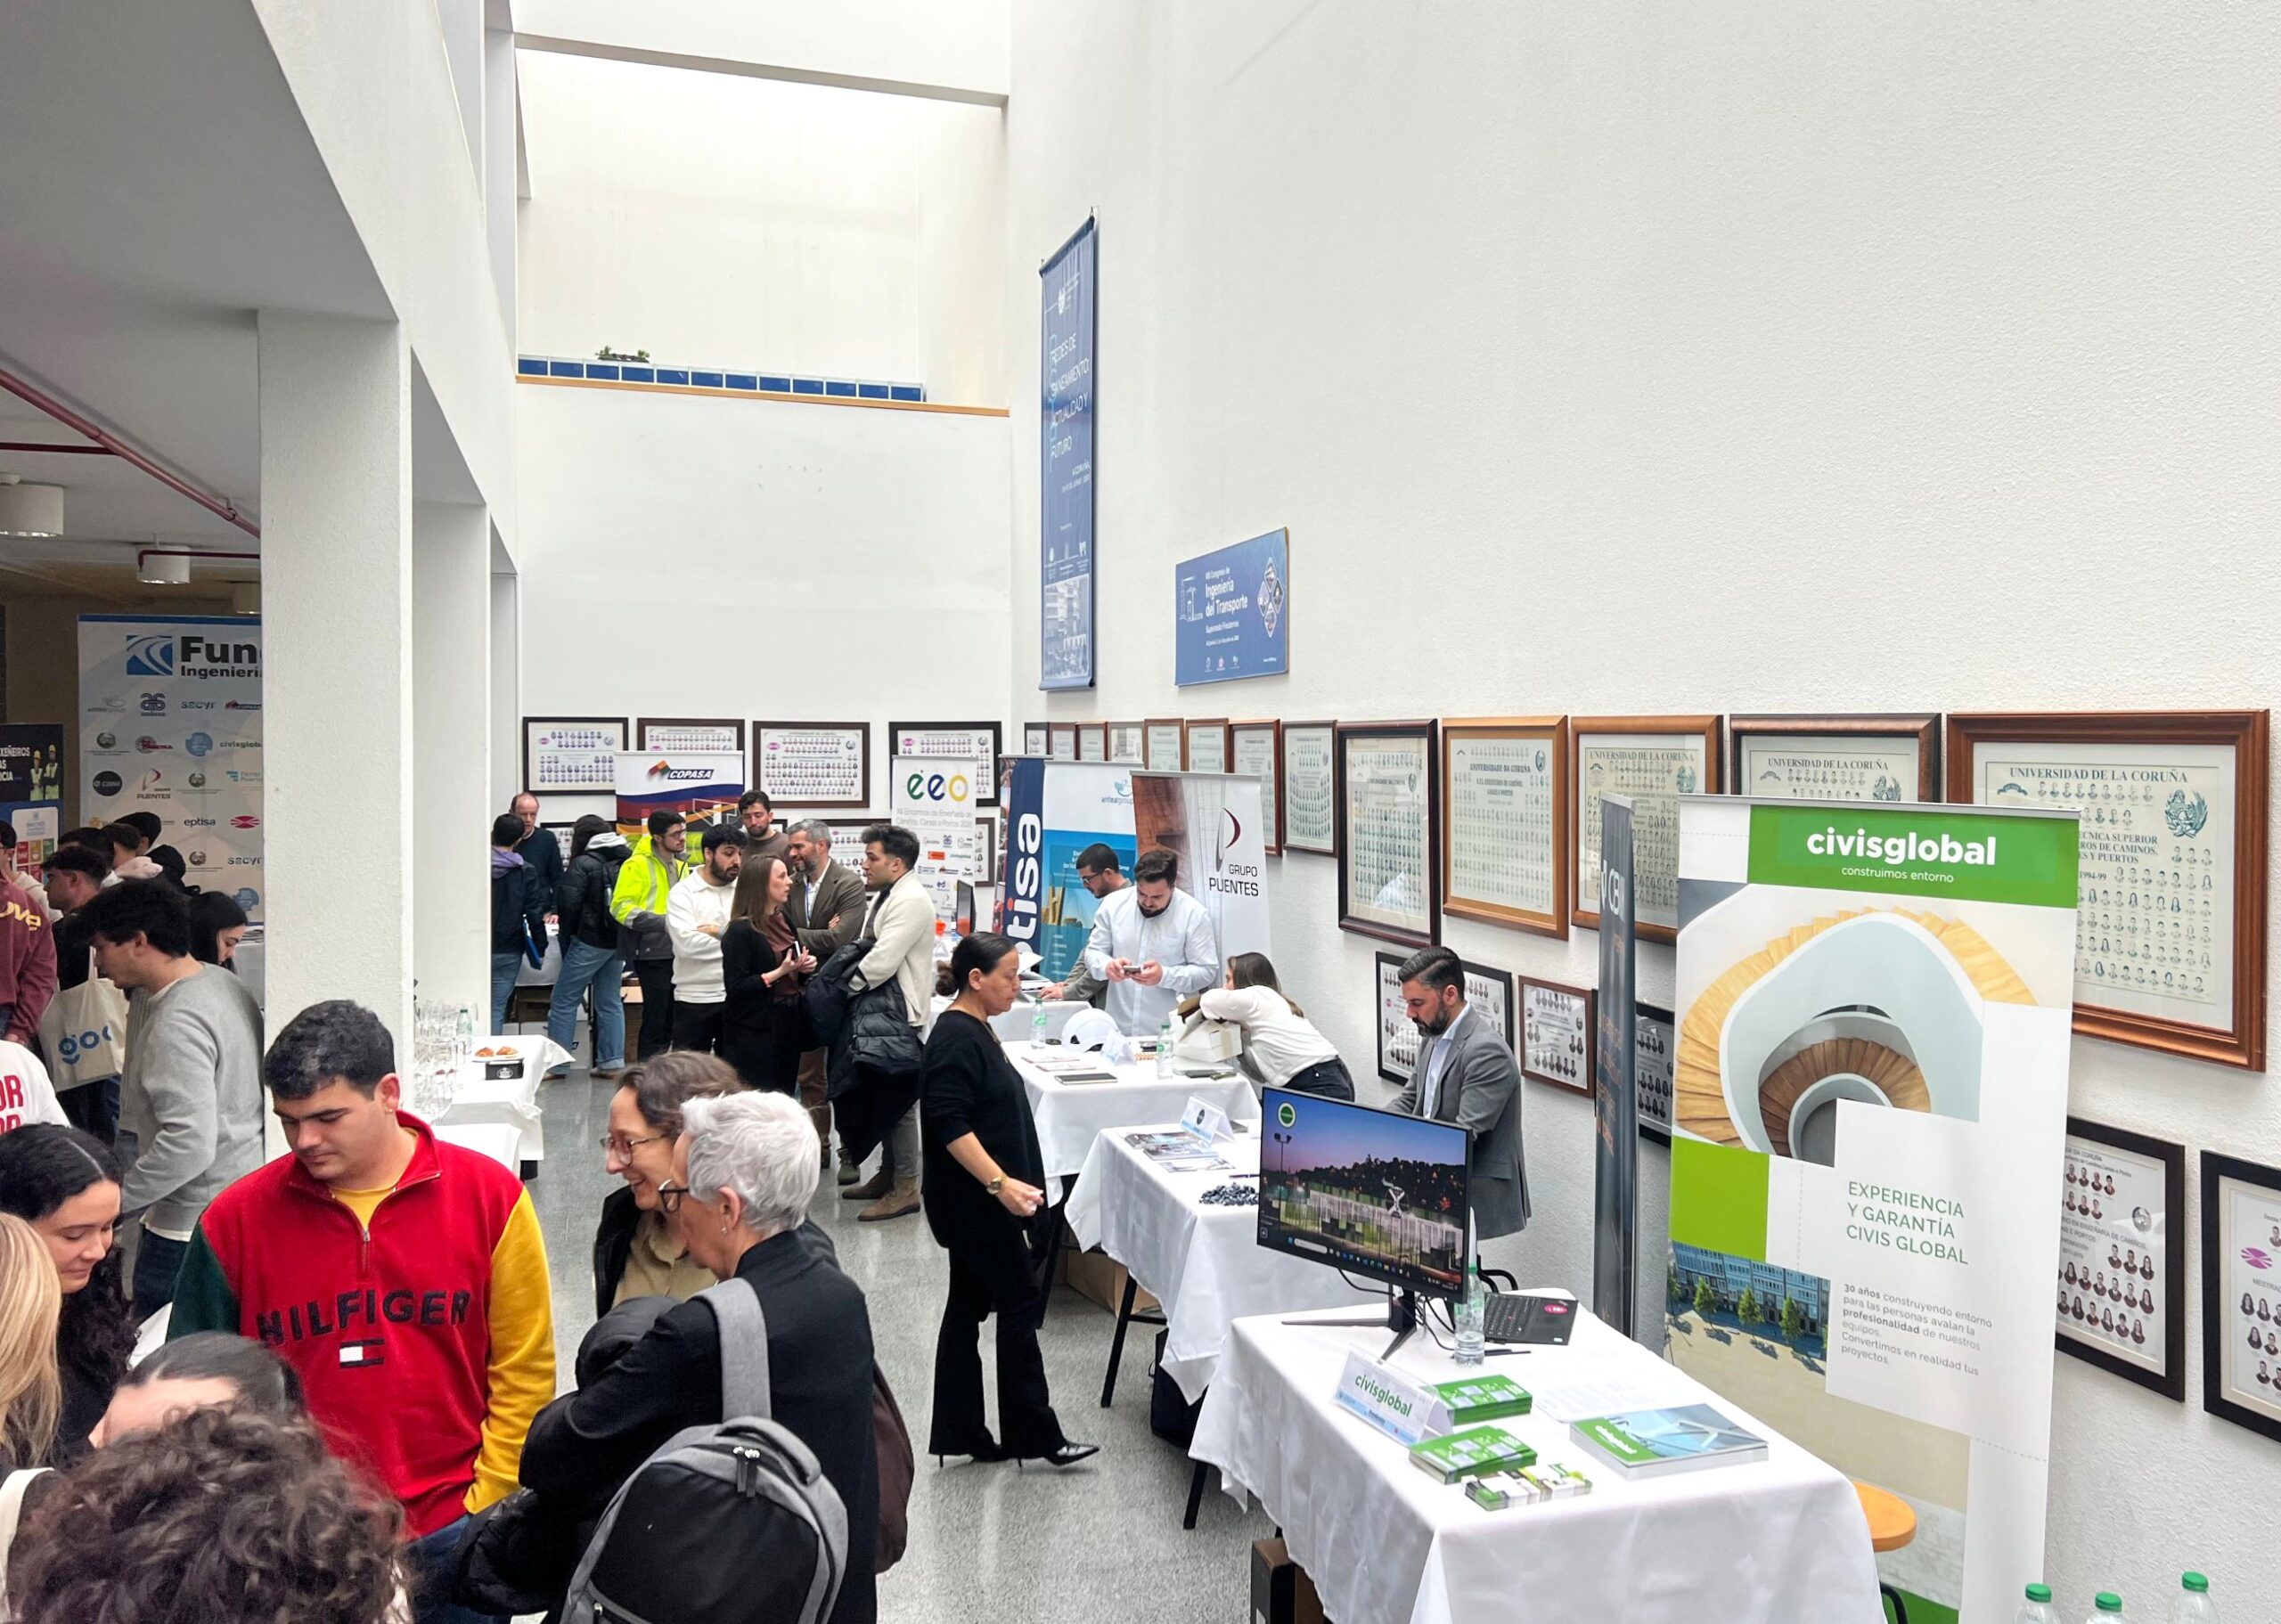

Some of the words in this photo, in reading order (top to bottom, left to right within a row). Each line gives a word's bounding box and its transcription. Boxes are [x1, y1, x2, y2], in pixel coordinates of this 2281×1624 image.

[1206, 600, 1215, 617] del
[1215, 593, 1248, 616] Transporte
[181, 636, 262, 664] Fun
[181, 665, 262, 680] Ingenierí
[219, 741, 263, 749] civisglob
[1590, 751, 1637, 761] UNIVERSIDAD
[1639, 752, 1648, 761] DE
[1649, 752, 1660, 761] LA
[1768, 758, 1822, 769] UNIVERSIDAD
[1824, 759, 1835, 768] DE
[1837, 760, 1848, 769] LA
[1850, 759, 1889, 771] CORUÑA
[669, 769, 713, 779] COPASA
[2010, 767, 2089, 780] UNIVERSIDAD
[2092, 770, 2108, 780] DE
[2112, 771, 2128, 781] LA
[2131, 769, 2188, 783] CORUÑA
[184, 818, 217, 828] eptisa
[1806, 826, 1997, 866] civisglobal
[2099, 842, 2111, 852] DE
[2112, 833, 2158, 845] SUPERIOR
[2089, 852, 2095, 861] Y
[2097, 853, 2139, 864] PUERTOS
[1229, 863, 1258, 877] GRUPO
[1841, 866, 1908, 881] construimos
[1910, 869, 1955, 884] entorno
[1209, 877, 1260, 897] PUENTES
[1848, 1180, 1965, 1219] EXPERIENCIA
[1847, 1202, 1860, 1218] Y
[1862, 1205, 1956, 1239] GARANTÍA
[1846, 1224, 1891, 1247] CIVIS
[1895, 1235, 1968, 1265] GLOBAL
[1844, 1284, 1856, 1293] 30
[1858, 1285, 1882, 1300] años
[1883, 1293, 1953, 1318] construyendo
[1955, 1309, 1992, 1328] entorno
[1844, 1294, 1864, 1310] para
[1867, 1299, 1881, 1313] las
[1883, 1305, 1929, 1325] personas
[1931, 1316, 1965, 1334] avalan
[1966, 1325, 1975, 1336] la
[256, 1289, 471, 1346] HILFIGER
[1842, 1318, 1882, 1339] equipos.
[1843, 1307, 1920, 1335] profesionalidad
[1922, 1327, 1937, 1339] de
[1939, 1333, 1981, 1351] nuestros
[1841, 1331, 1902, 1356] Convertimos
[1904, 1348, 1917, 1359] en
[1919, 1351, 1962, 1371] realidad
[1964, 1364, 1980, 1376] tus
[1841, 1343, 1890, 1366] proyectos.
[1354, 1374, 1413, 1418] civisglobal
